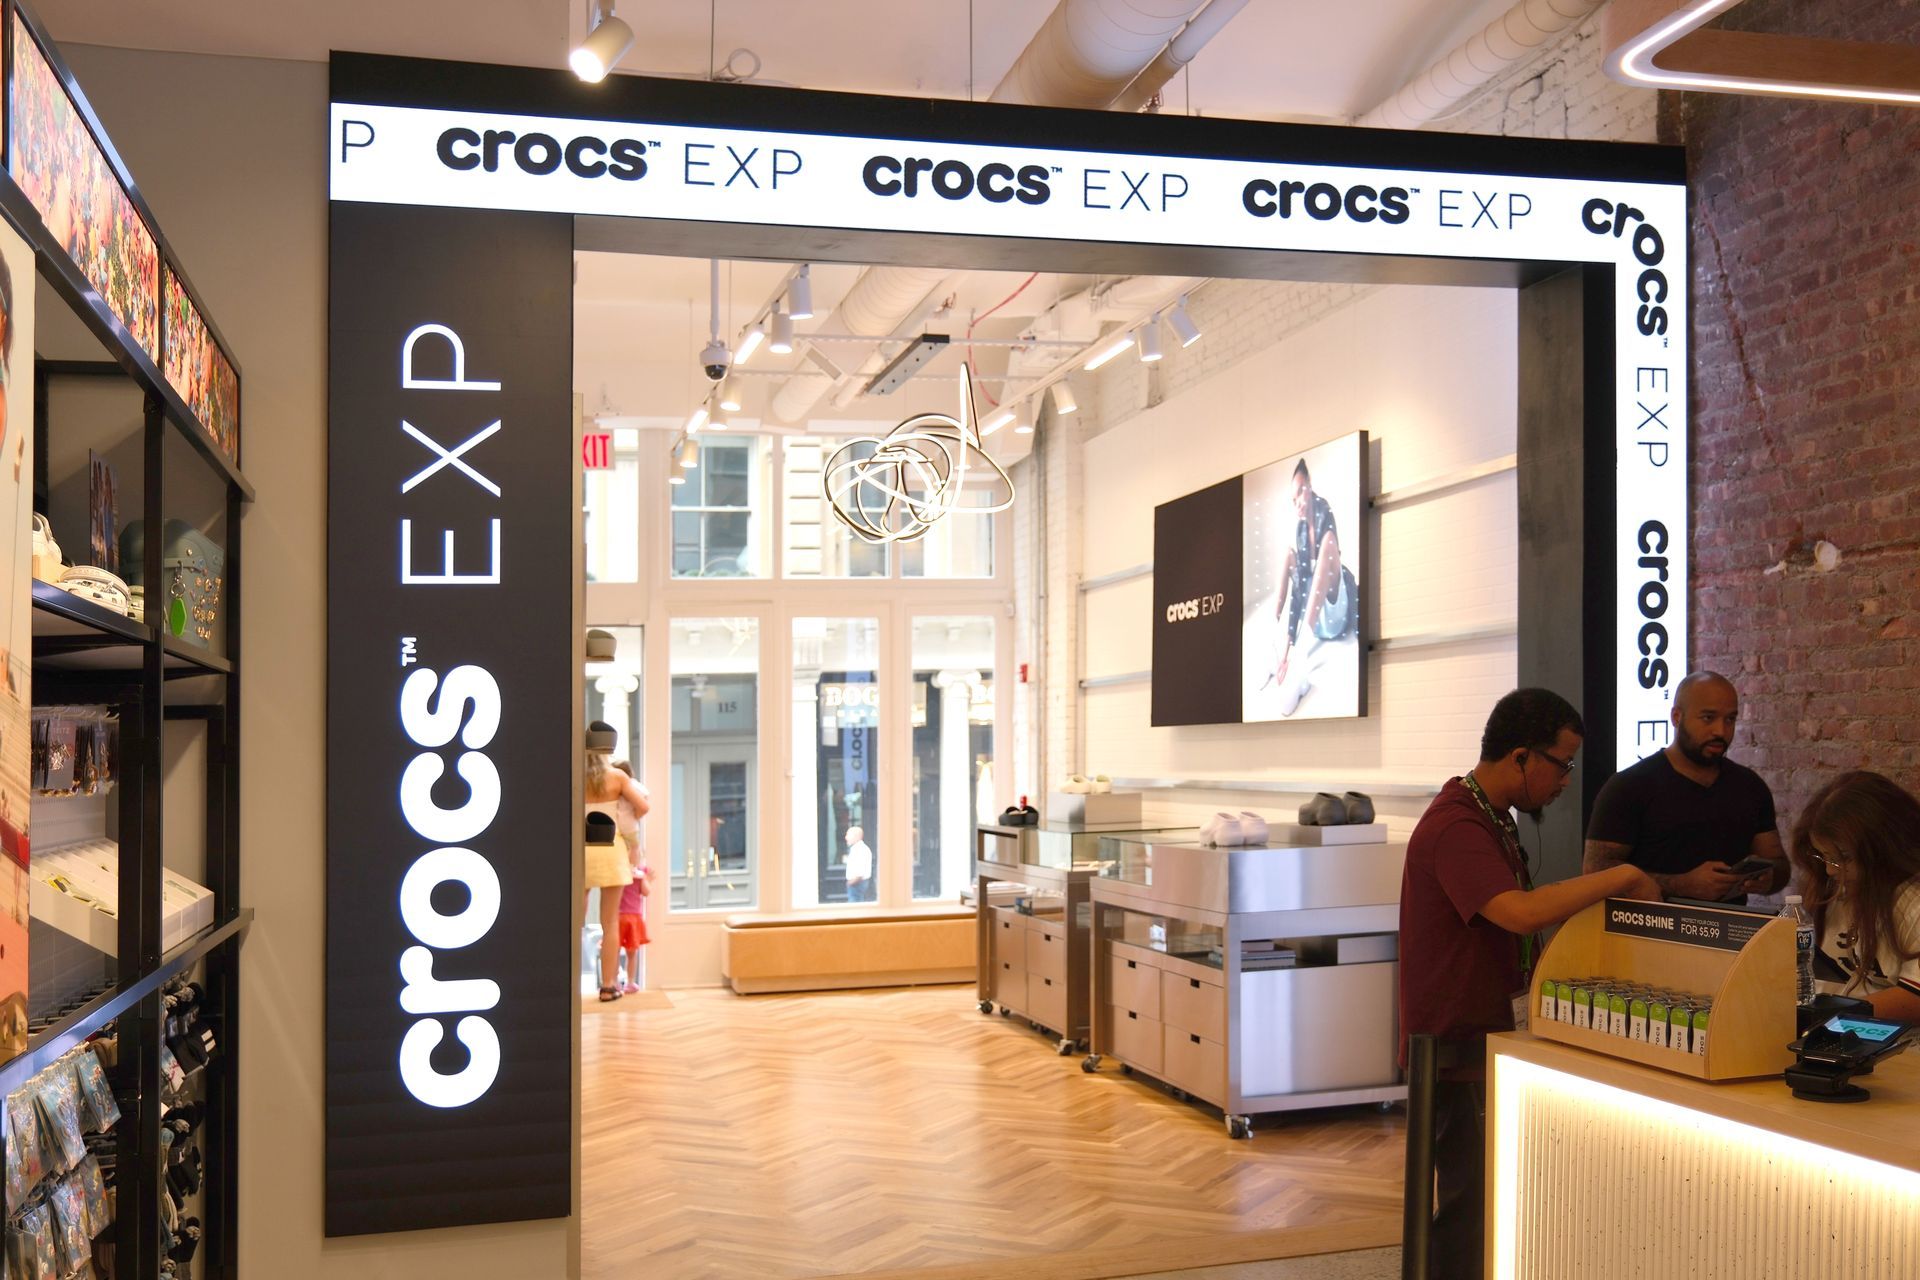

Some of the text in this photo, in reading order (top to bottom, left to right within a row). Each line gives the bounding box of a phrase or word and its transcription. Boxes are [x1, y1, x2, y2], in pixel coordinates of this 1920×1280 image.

[342, 120, 375, 163] P
[685, 143, 803, 189] EXP
[1084, 169, 1188, 212] EXP
[1440, 190, 1532, 229] EXP
[1637, 367, 1669, 467] EXP
[402, 324, 502, 585] EXP
[1203, 594, 1224, 616] EXP
[717, 702, 737, 713] 115
[1612, 910, 1674, 930] CROCS SHINE
[1681, 924, 1698, 935] FOR
[1699, 926, 1720, 939] $5.99
